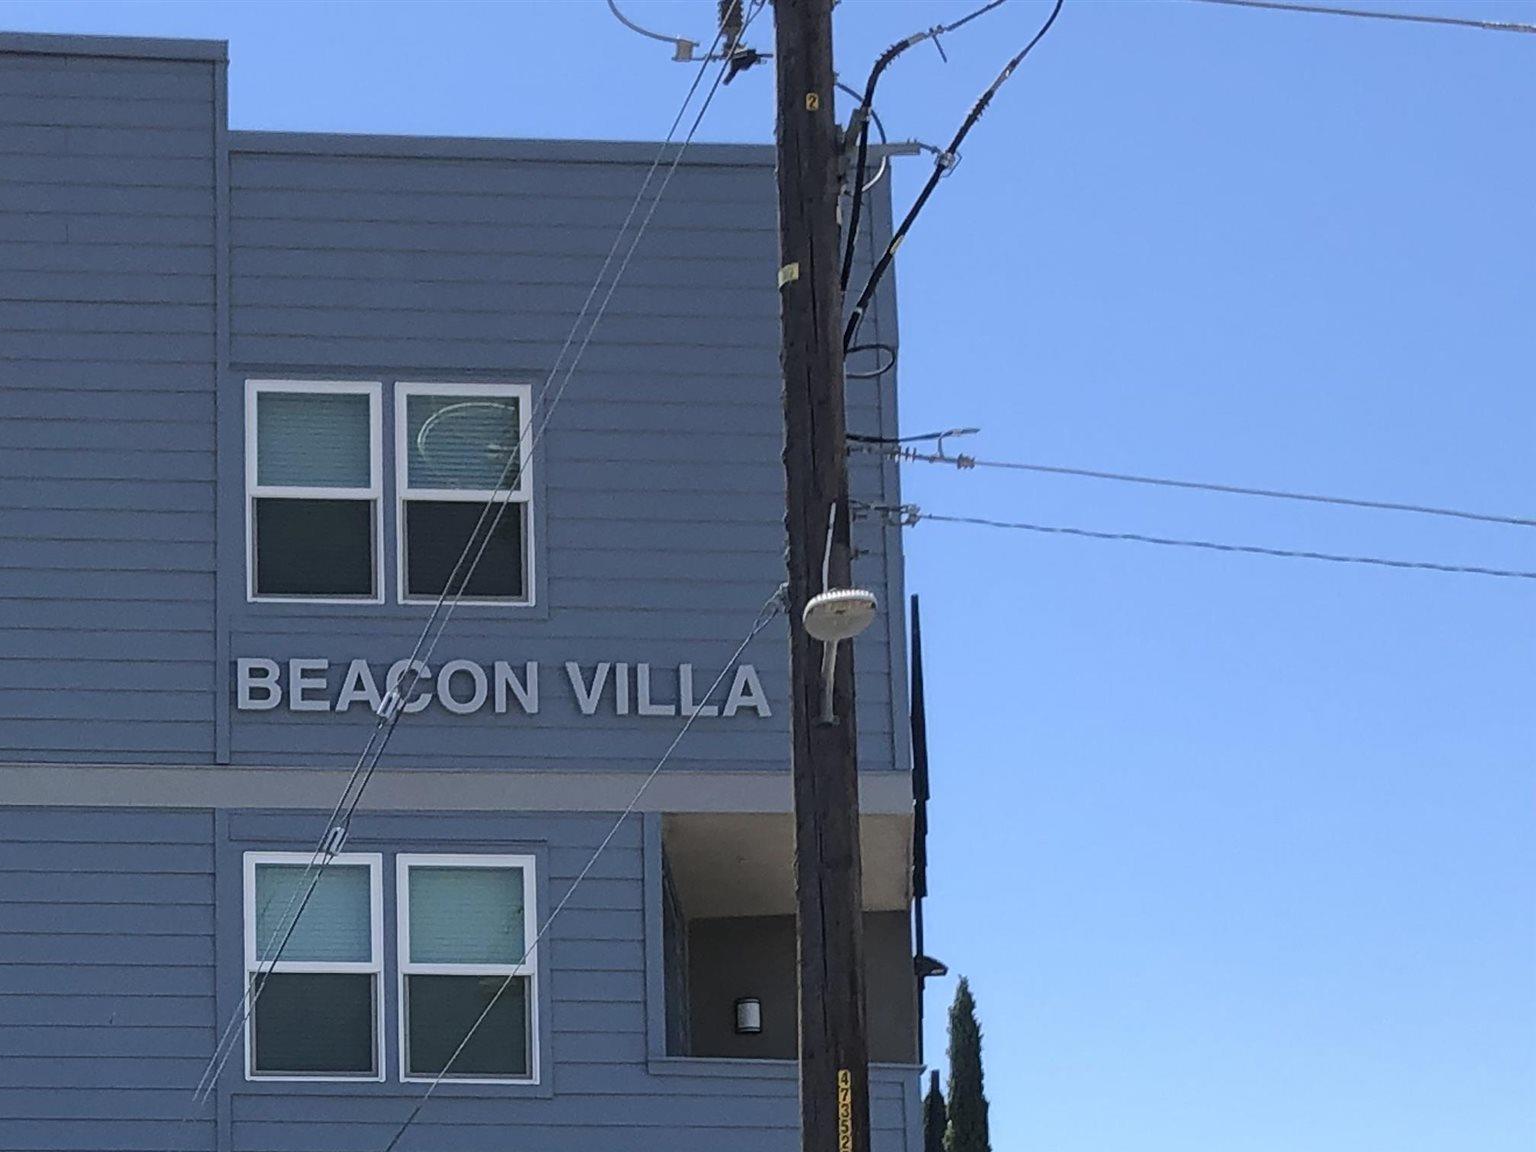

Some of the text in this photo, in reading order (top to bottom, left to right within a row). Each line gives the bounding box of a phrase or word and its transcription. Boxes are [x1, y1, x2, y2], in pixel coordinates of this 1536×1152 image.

[807, 94, 818, 109] 2
[236, 657, 773, 718] BEACON VILLA
